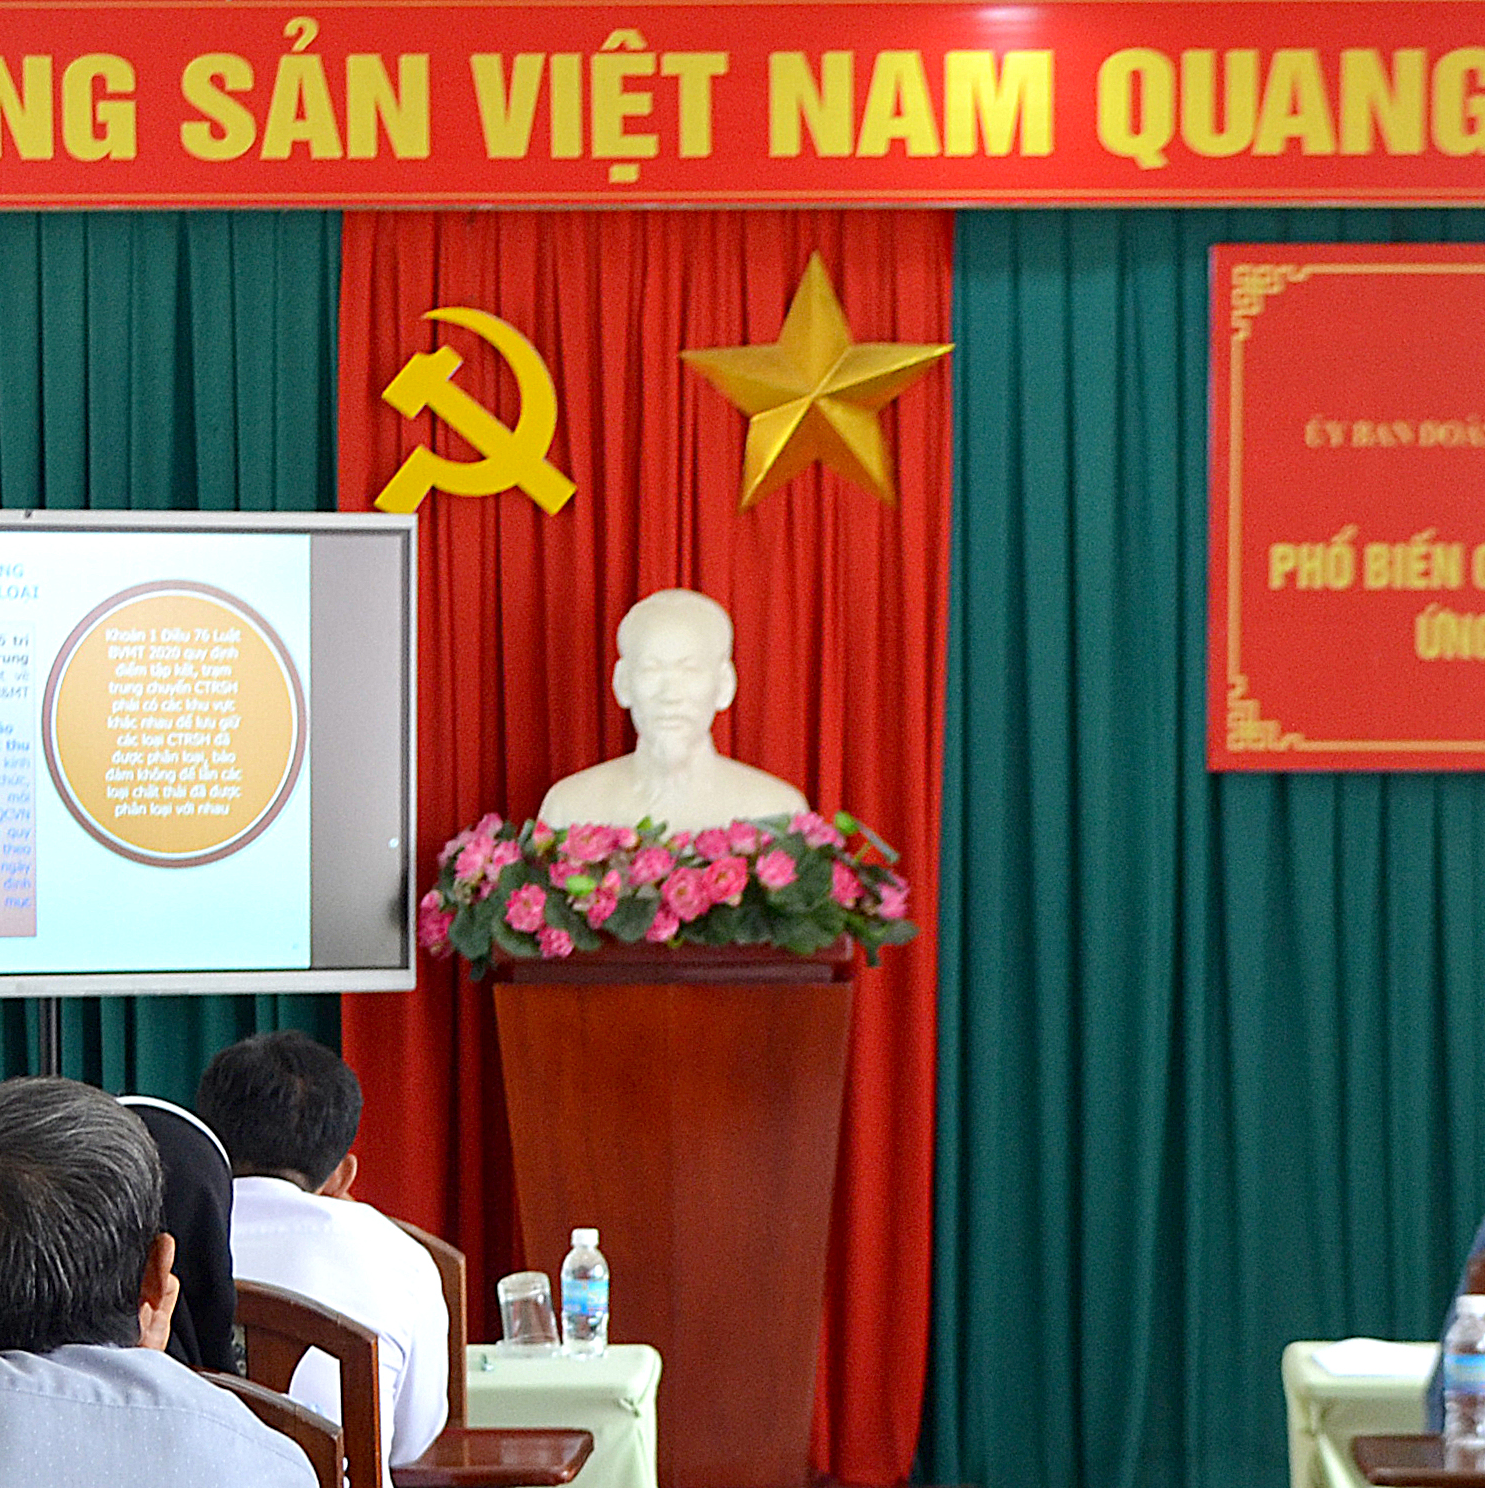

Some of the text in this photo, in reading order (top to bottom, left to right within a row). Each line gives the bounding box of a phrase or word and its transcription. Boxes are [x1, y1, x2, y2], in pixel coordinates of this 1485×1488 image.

[181, 17, 429, 161] SẢN
[471, 28, 728, 182] VIỆT
[767, 49, 1055, 157] NAM
[1269, 524, 1357, 590] PHỔ
[1364, 525, 1461, 590] BIẾN
